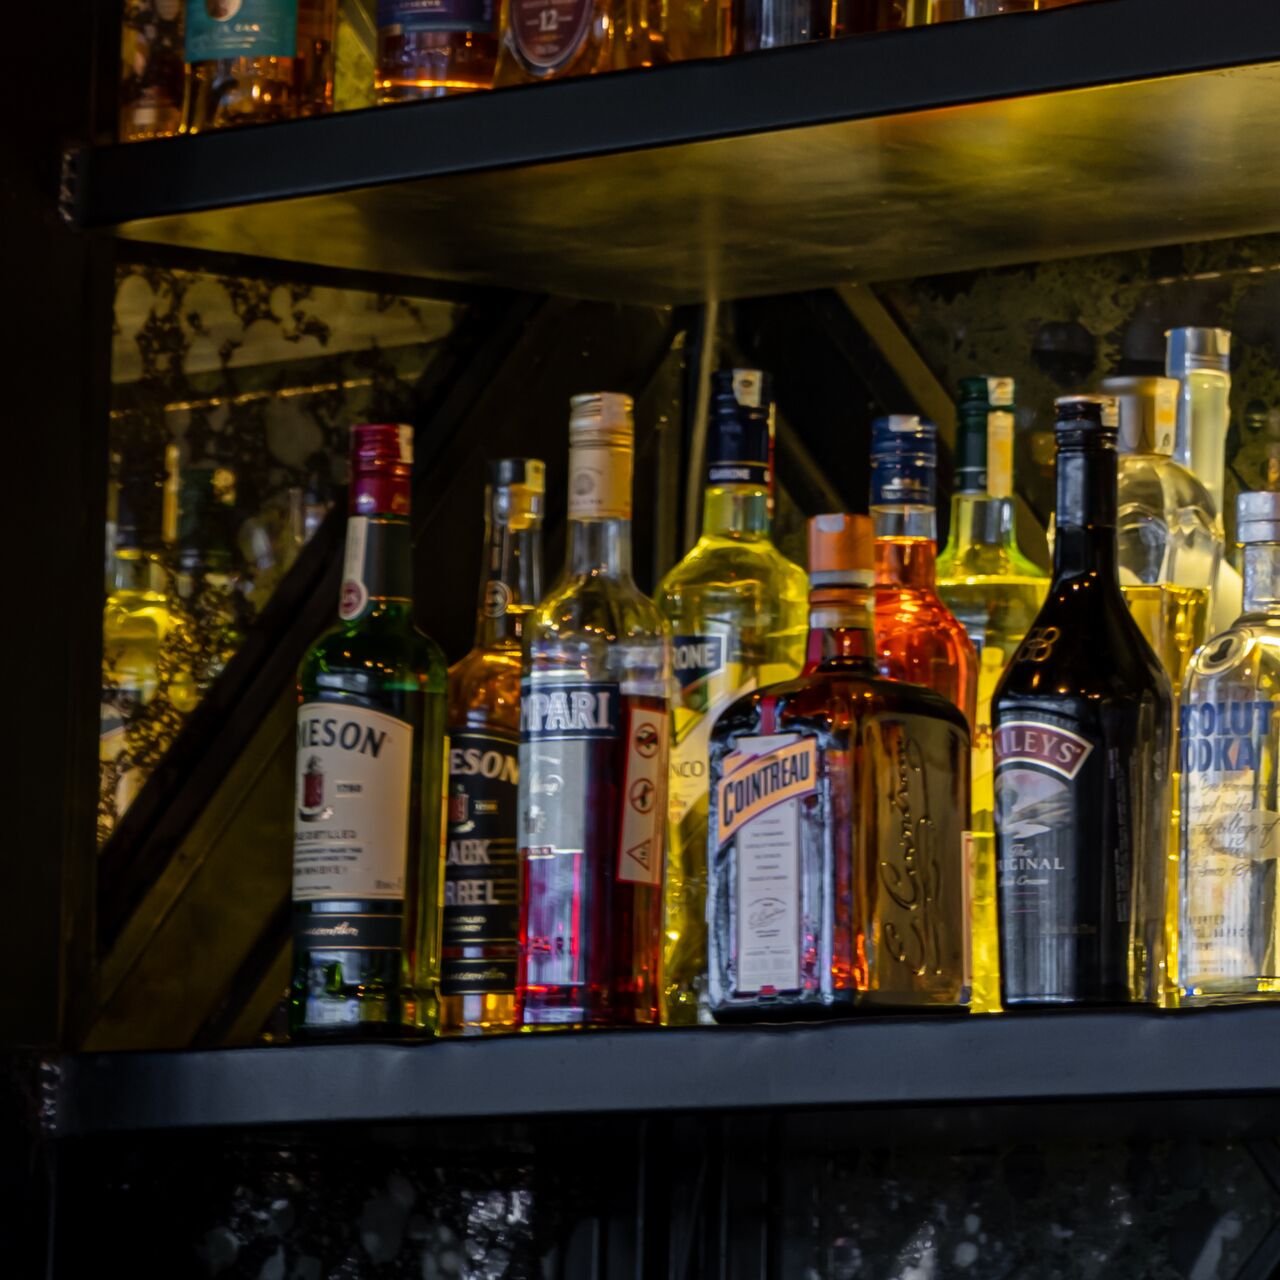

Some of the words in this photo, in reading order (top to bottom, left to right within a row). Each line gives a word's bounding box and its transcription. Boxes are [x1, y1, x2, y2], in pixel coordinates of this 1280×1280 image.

[538, 8, 559, 32] 12
[1181, 737, 1256, 775] ODKA
[722, 750, 811, 829] COINTREAU
[1010, 843, 1033, 858] The
